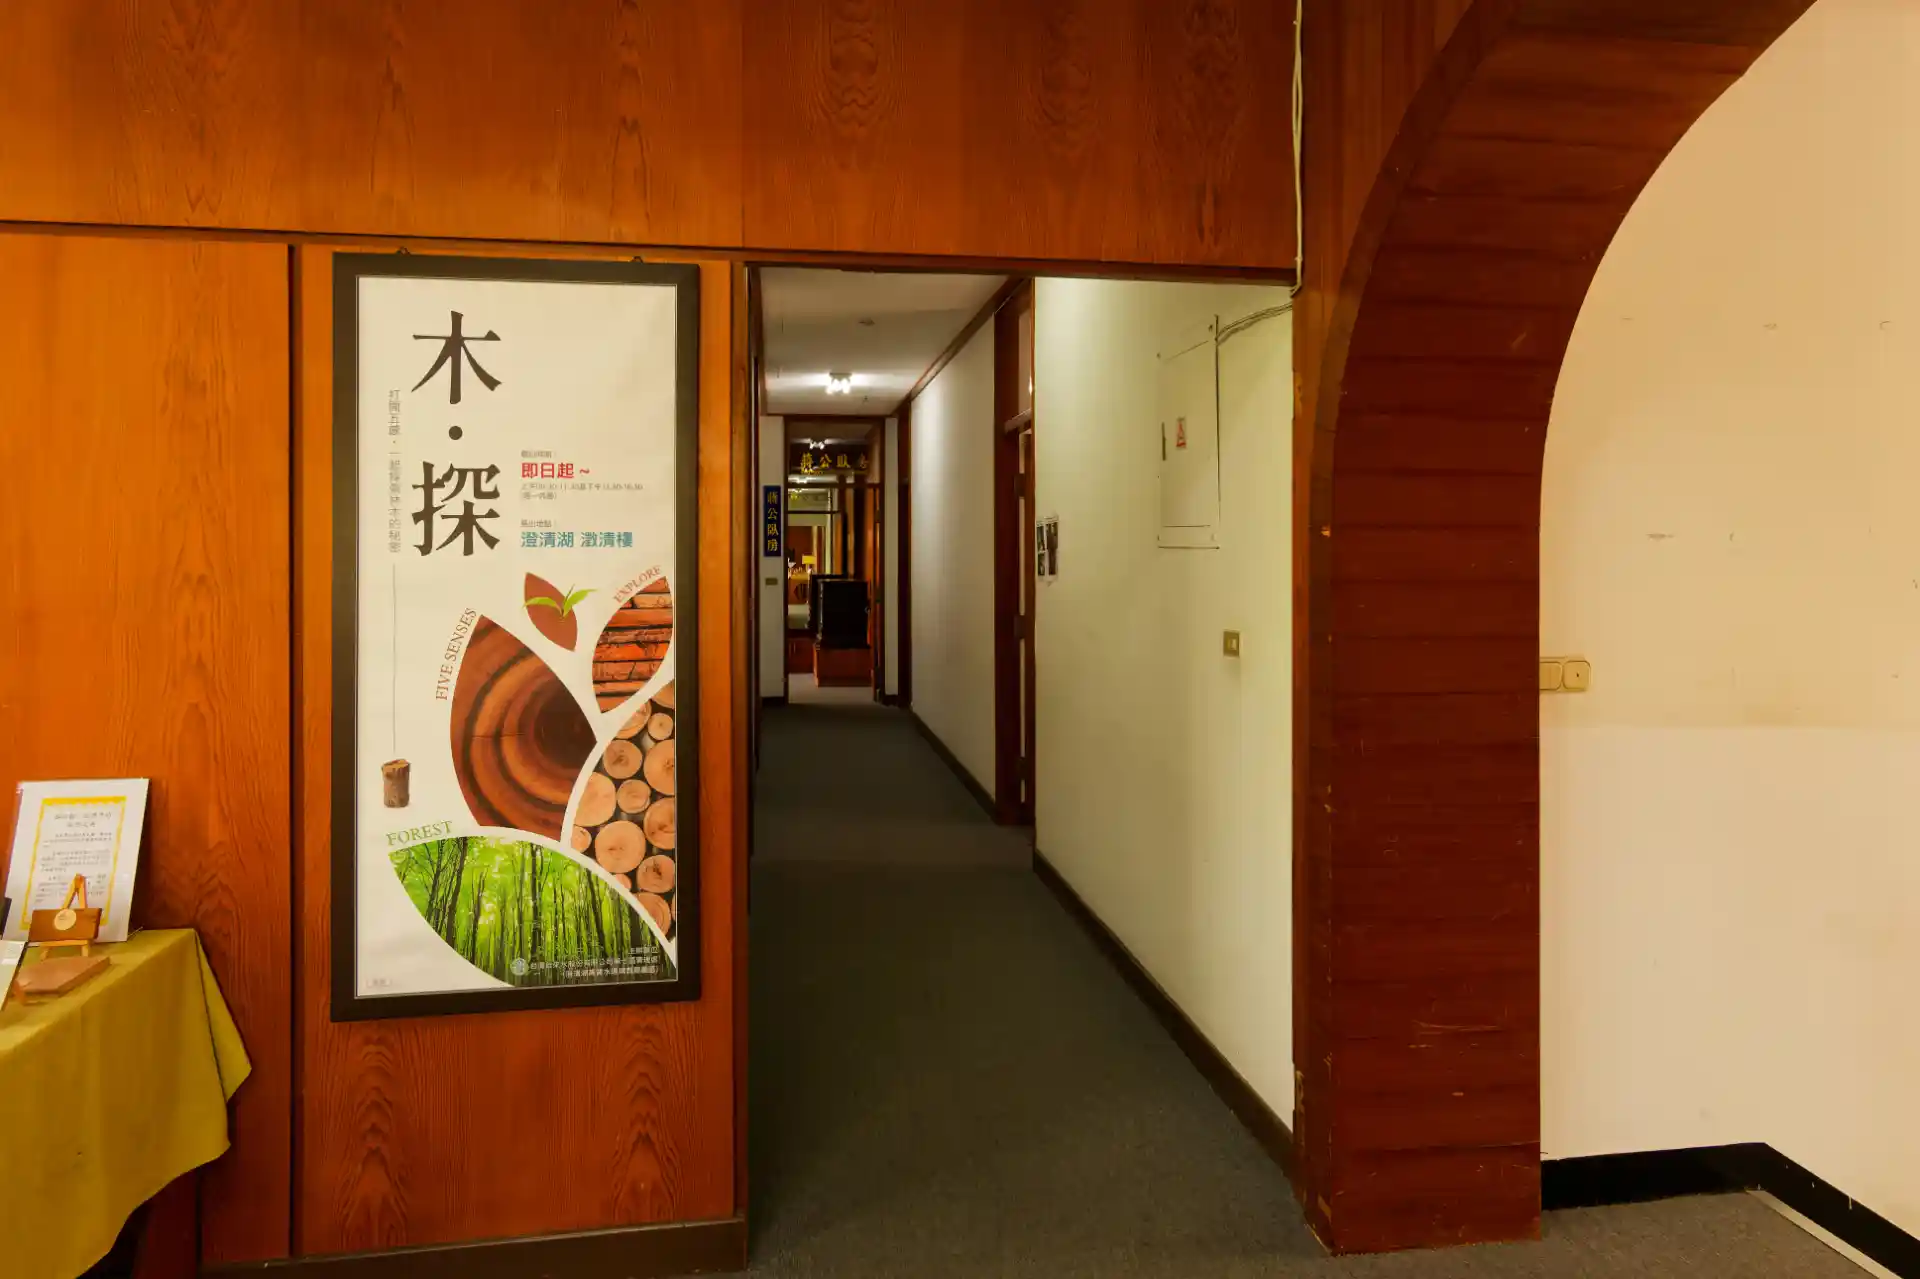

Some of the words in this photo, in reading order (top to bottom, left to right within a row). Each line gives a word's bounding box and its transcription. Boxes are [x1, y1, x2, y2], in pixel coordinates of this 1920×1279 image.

[521, 462, 575, 479] 即日起
[521, 531, 575, 548] 澄清湖
[767, 491, 779, 552] 蔣公臥房
[613, 564, 662, 604] EXPLORE
[444, 607, 477, 661] SENSES
[436, 664, 454, 700] FIVE
[386, 820, 453, 846] FOREST
